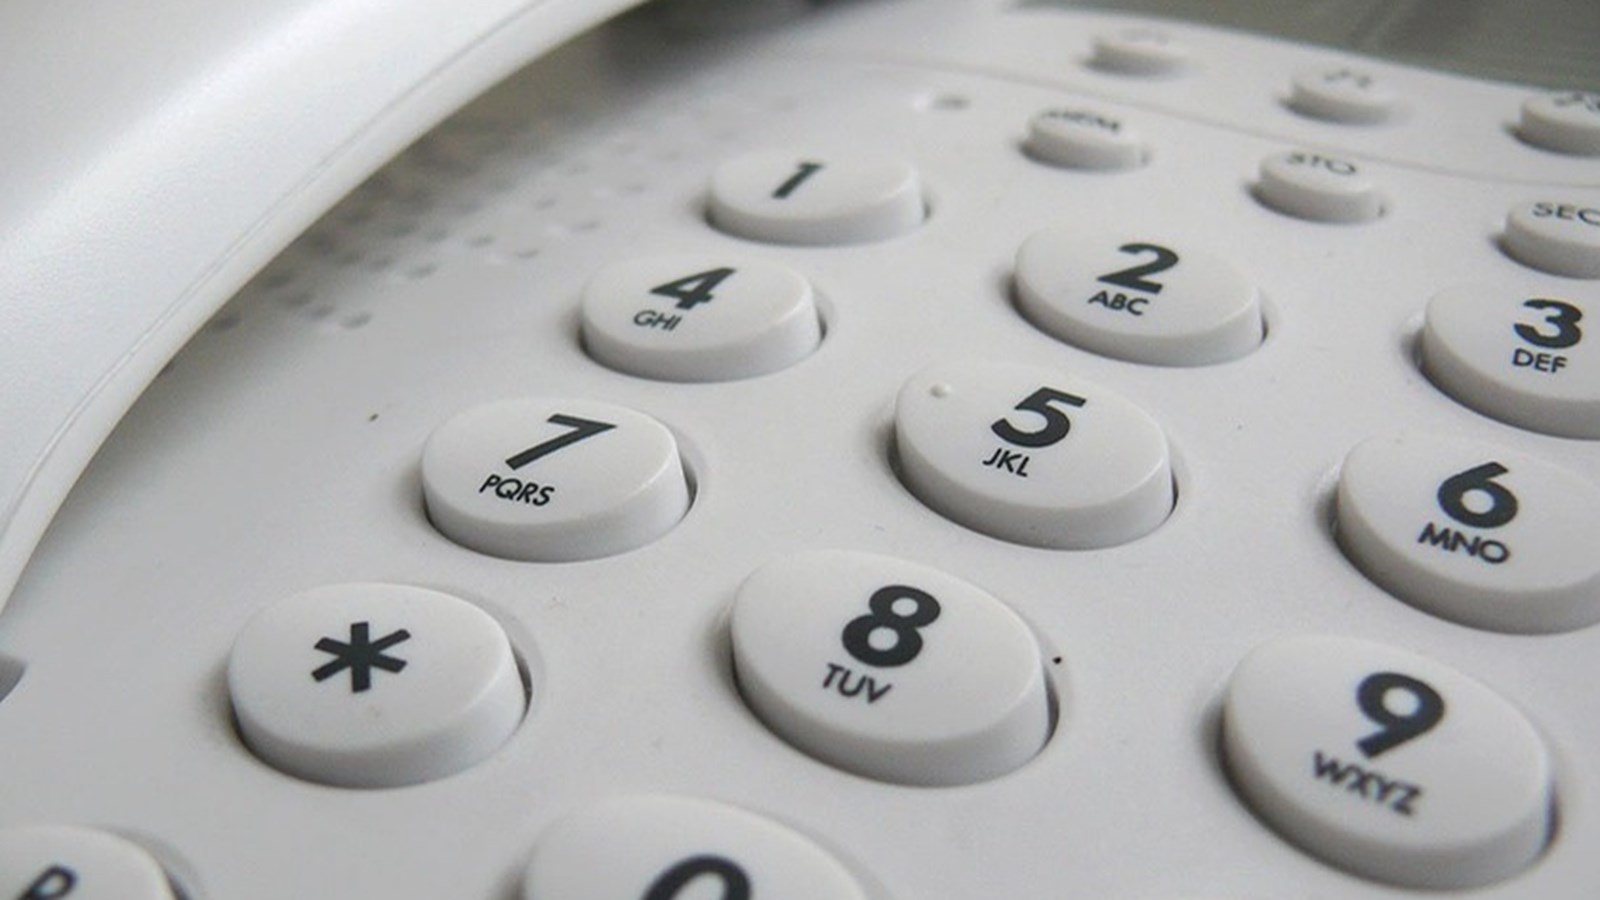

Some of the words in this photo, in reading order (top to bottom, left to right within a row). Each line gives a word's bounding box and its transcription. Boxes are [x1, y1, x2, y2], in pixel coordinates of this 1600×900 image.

[771, 162, 822, 200] 1
[1286, 153, 1357, 177] STO
[649, 267, 736, 310] 4
[1097, 242, 1179, 295] 2
[633, 309, 682, 331] GHI
[1087, 290, 1149, 316] ABC
[1513, 298, 1583, 349] 3
[1512, 347, 1567, 374] DEF
[990, 386, 1087, 449] 5
[505, 413, 617, 471] 7
[982, 447, 1030, 478] JKL
[478, 473, 555, 506] PQRS
[1436, 461, 1519, 530] 6
[1417, 521, 1511, 565] MNO
[841, 585, 942, 669] 8
[822, 662, 893, 704] TUV
[1355, 671, 1446, 760] 9
[1313, 750, 1422, 817] WXYZ
